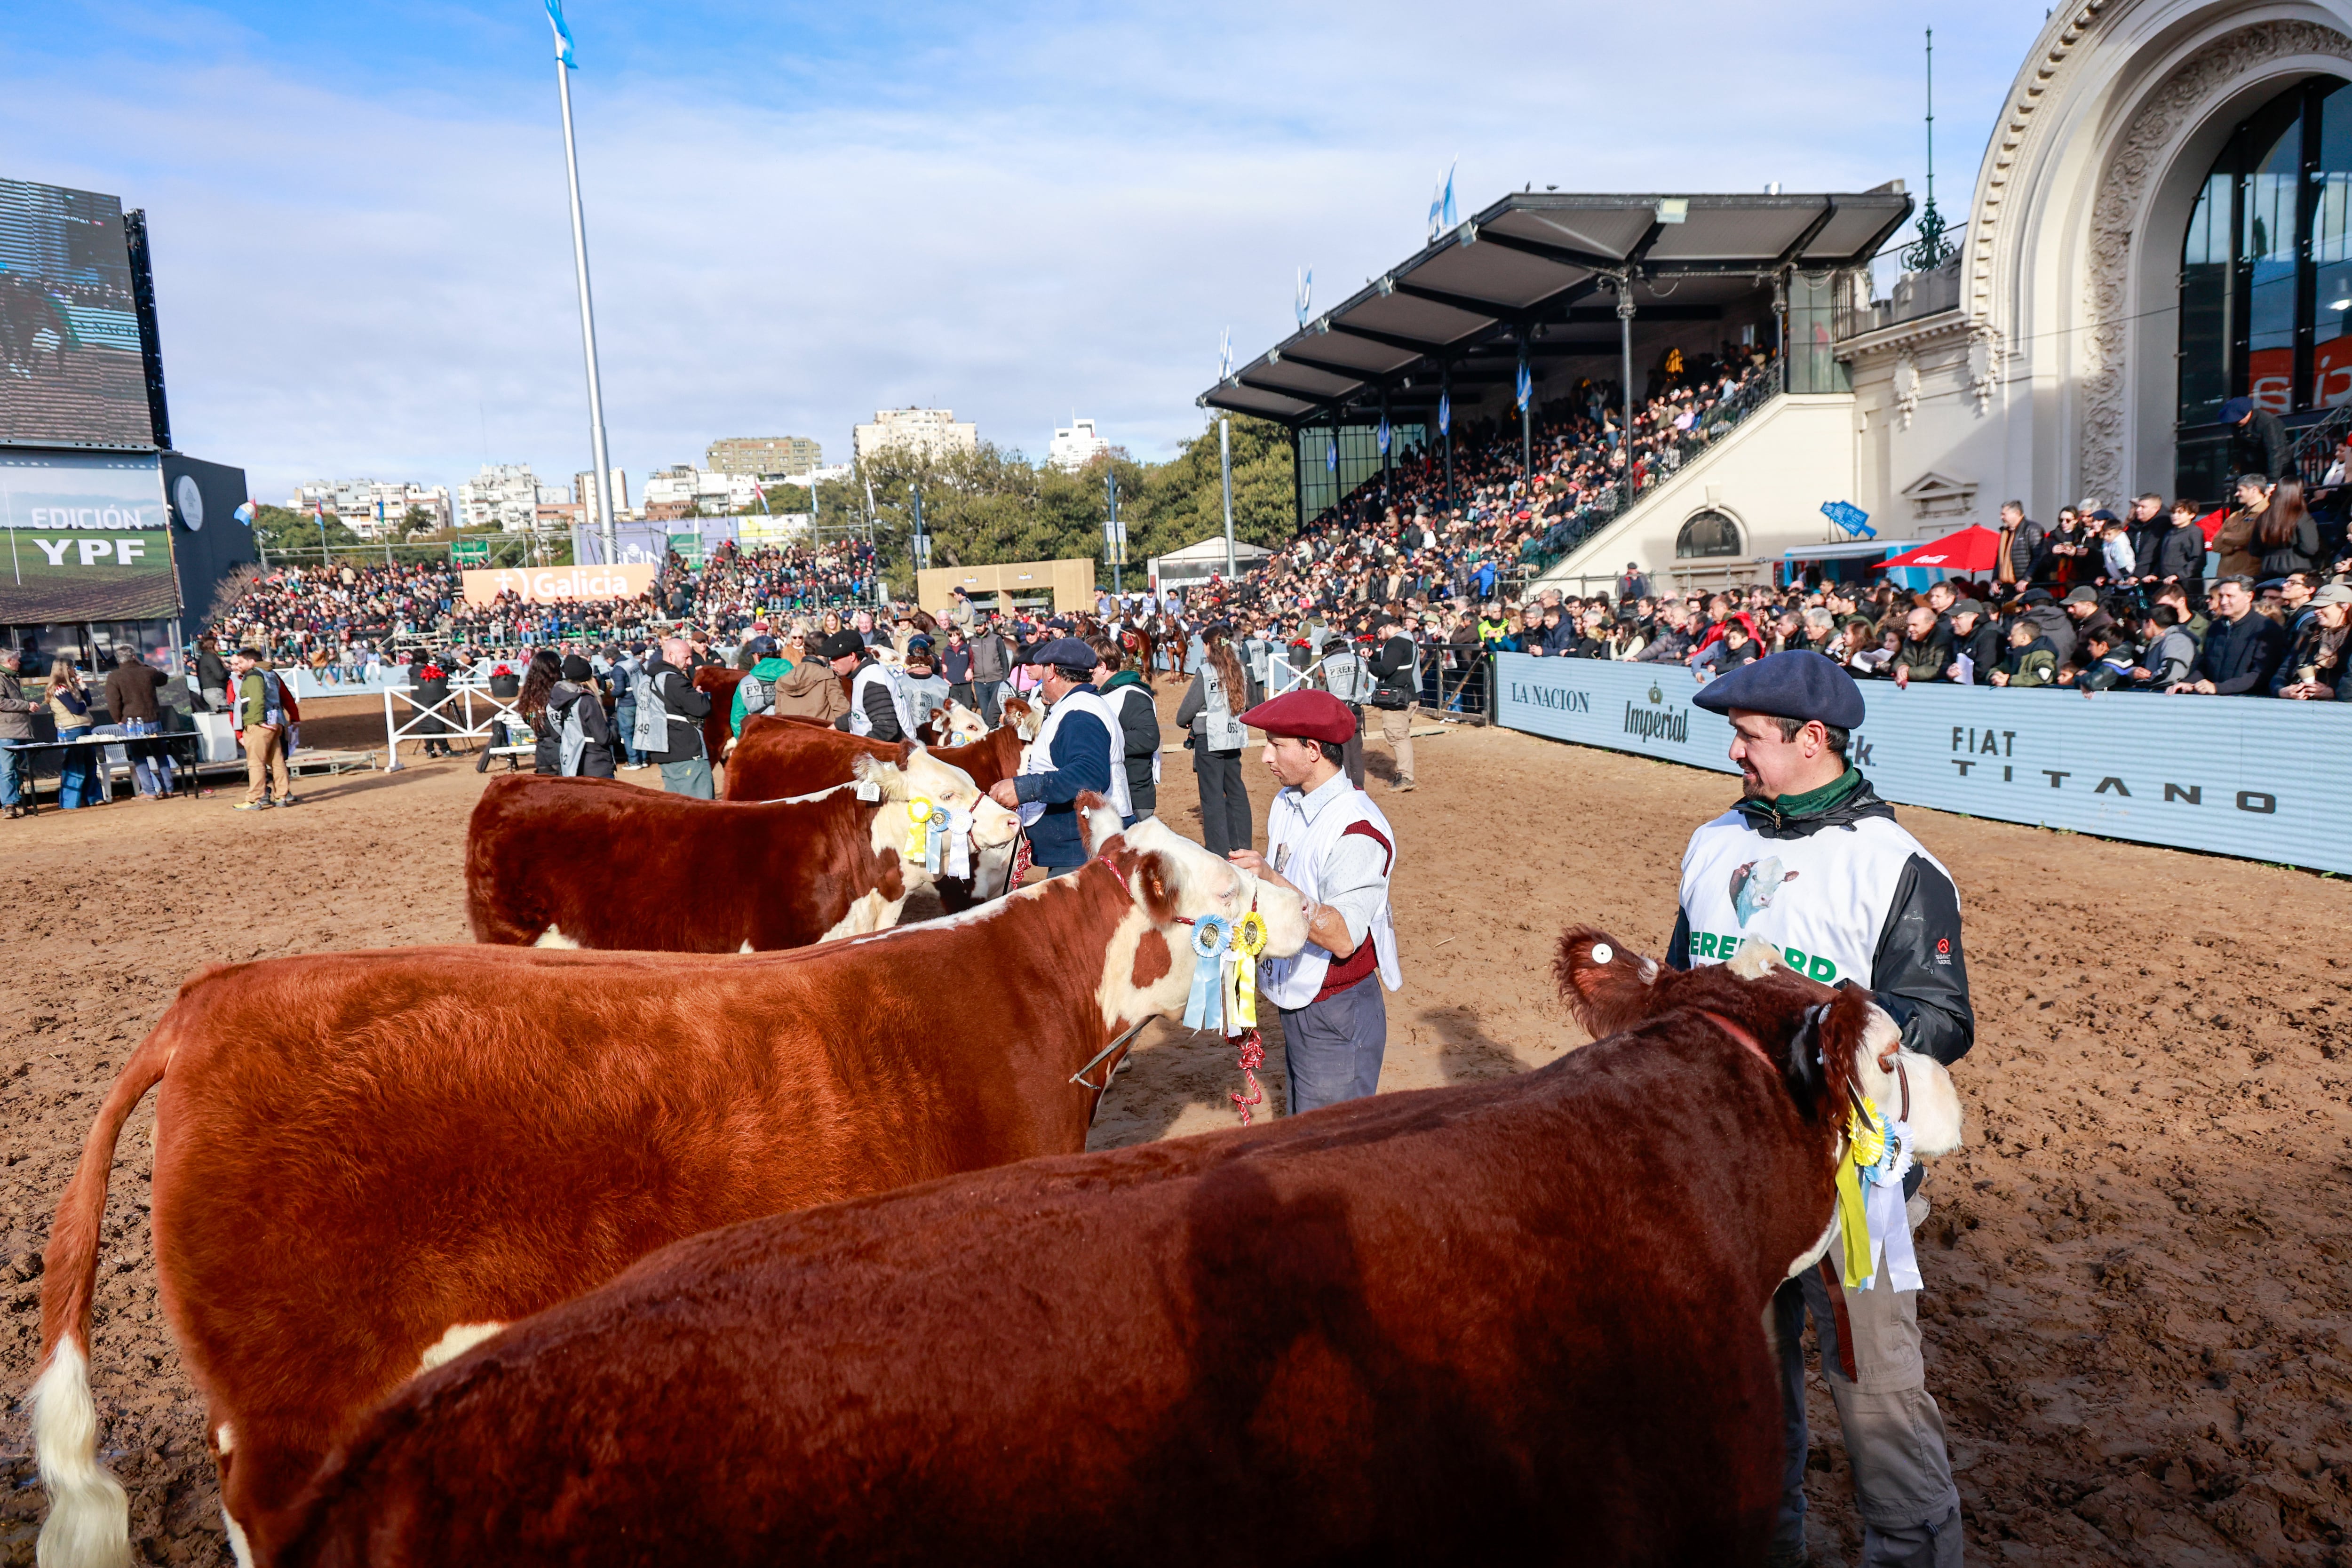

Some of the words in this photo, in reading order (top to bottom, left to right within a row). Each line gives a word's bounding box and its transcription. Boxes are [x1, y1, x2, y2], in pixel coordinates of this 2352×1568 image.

[31, 504, 143, 530] EDICIÓN
[32, 539, 145, 565] YPF
[533, 569, 628, 597] Galicia
[1512, 683, 1529, 703] LA
[1533, 685, 1590, 713] NACION
[1624, 700, 1690, 743] Imperial
[1952, 726, 2016, 757] FIAT
[1951, 759, 2276, 814] TITANO
[1689, 931, 1836, 982] ERERD
